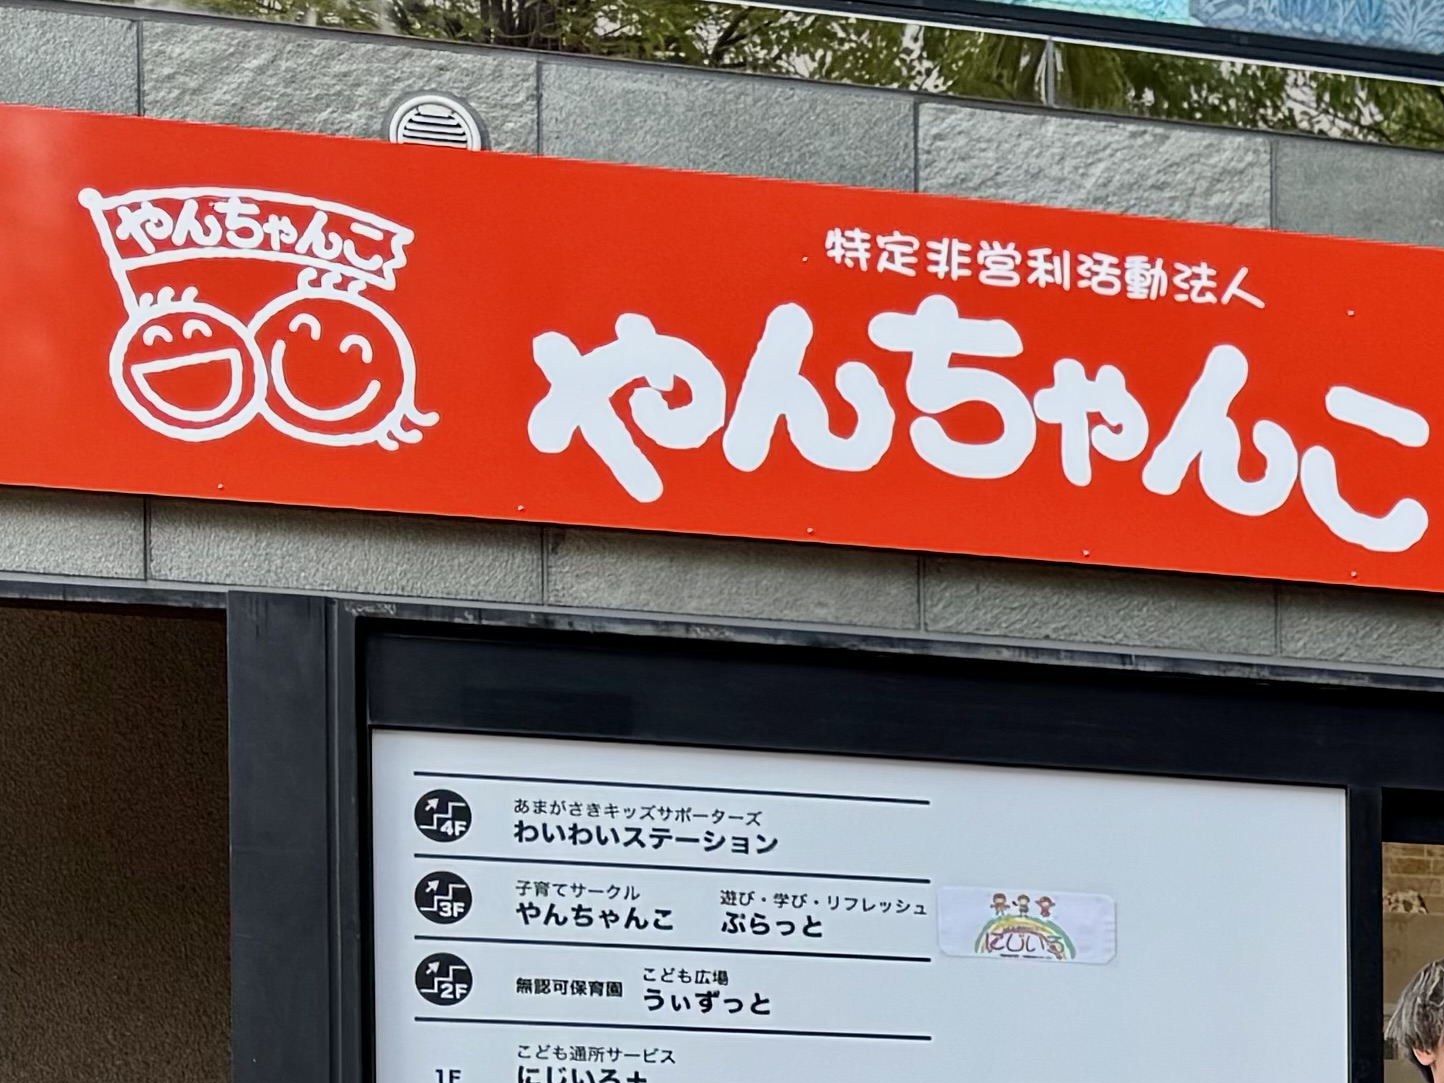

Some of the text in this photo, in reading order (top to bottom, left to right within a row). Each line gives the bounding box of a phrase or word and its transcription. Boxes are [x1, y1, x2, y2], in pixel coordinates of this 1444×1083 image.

[116, 197, 383, 270] やんちゃんこ
[825, 227, 1265, 309] 特定非営利活動法人
[528, 294, 1430, 552] やんちゃんこ
[514, 798, 762, 827] あまがさきキッズサポーターズ
[440, 819, 467, 837] 4F
[514, 820, 778, 855] わいわいステーション
[515, 880, 641, 901] 子育てサークル
[439, 901, 465, 917] 3F
[720, 890, 927, 916] 遊び・学び・リフレッシュ
[516, 902, 674, 931] やんちゃんこ
[516, 977, 623, 998] 無認可保育園
[643, 967, 729, 986] こども広場
[440, 983, 468, 999] 2F
[517, 1045, 676, 1065] こども通所サービス
